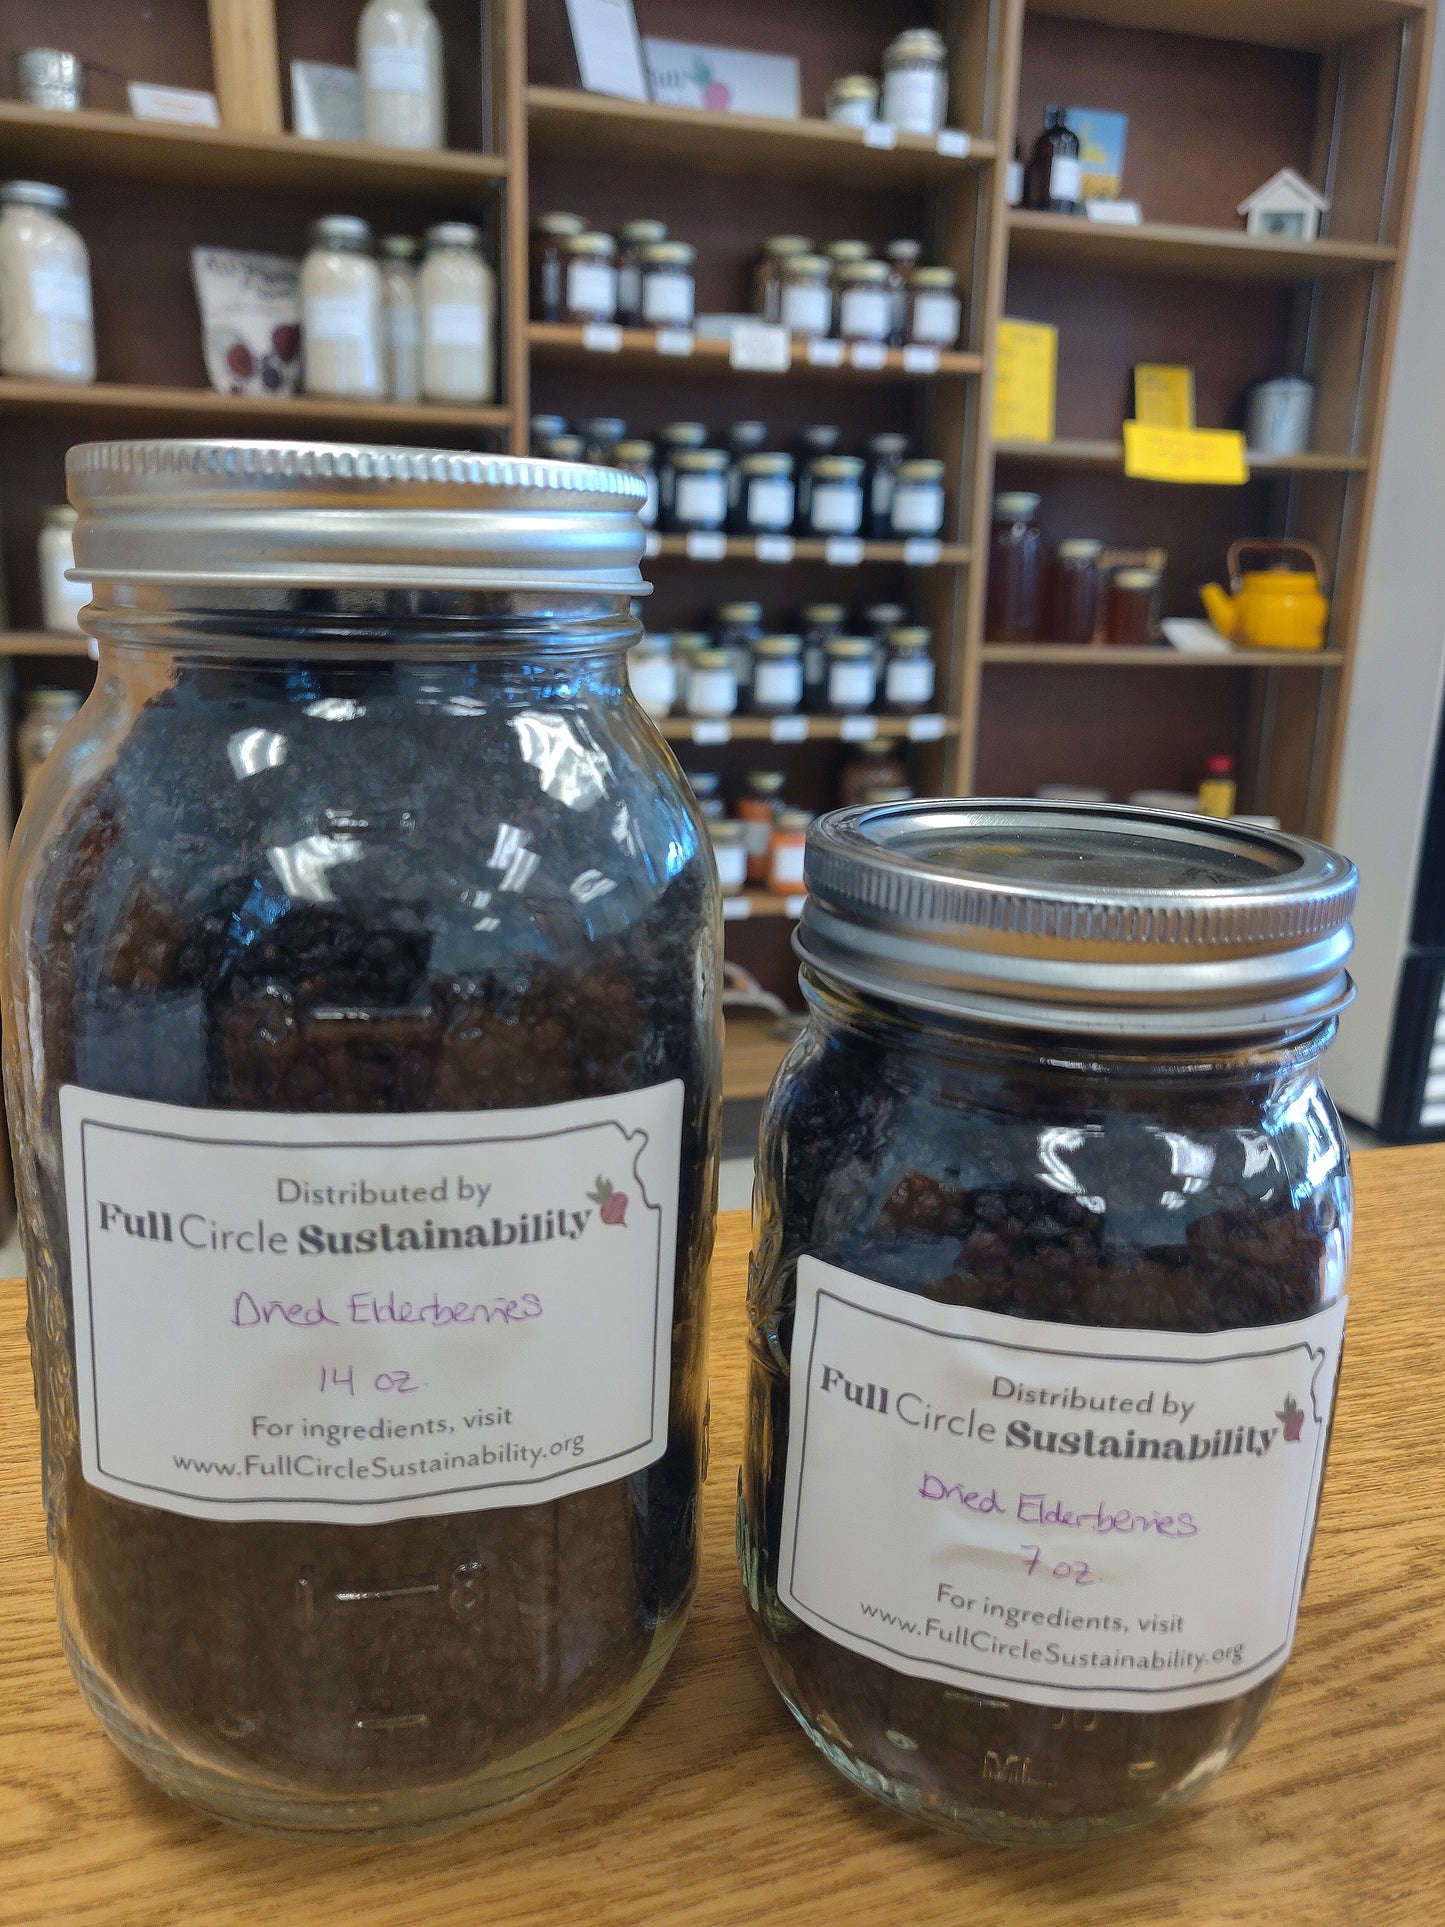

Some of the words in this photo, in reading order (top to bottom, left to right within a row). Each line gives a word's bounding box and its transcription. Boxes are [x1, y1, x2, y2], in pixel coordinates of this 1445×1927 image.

[277, 1176, 448, 1205] Distributed
[457, 1174, 492, 1209] by
[98, 1200, 174, 1242] Full
[180, 1213, 288, 1253] Circle
[299, 1208, 593, 1255] Sustainability
[319, 1364, 355, 1397] 14
[991, 1375, 1155, 1415] Distributed
[1161, 1391, 1195, 1425] by
[251, 1415, 295, 1438] For
[302, 1417, 456, 1446] ingredients,
[463, 1406, 513, 1429] visit
[819, 1363, 889, 1415] Full
[895, 1391, 996, 1443] Circle
[1004, 1418, 1280, 1461] Sustainability
[172, 1433, 585, 1480] www.FullCircleSustainability.org
[1020, 1543, 1041, 1577] 7
[935, 1582, 976, 1612] For
[982, 1596, 1130, 1633] ingredients,
[1137, 1613, 1185, 1634] visit
[859, 1599, 1246, 1673] www.FullCircleSustainability.org
